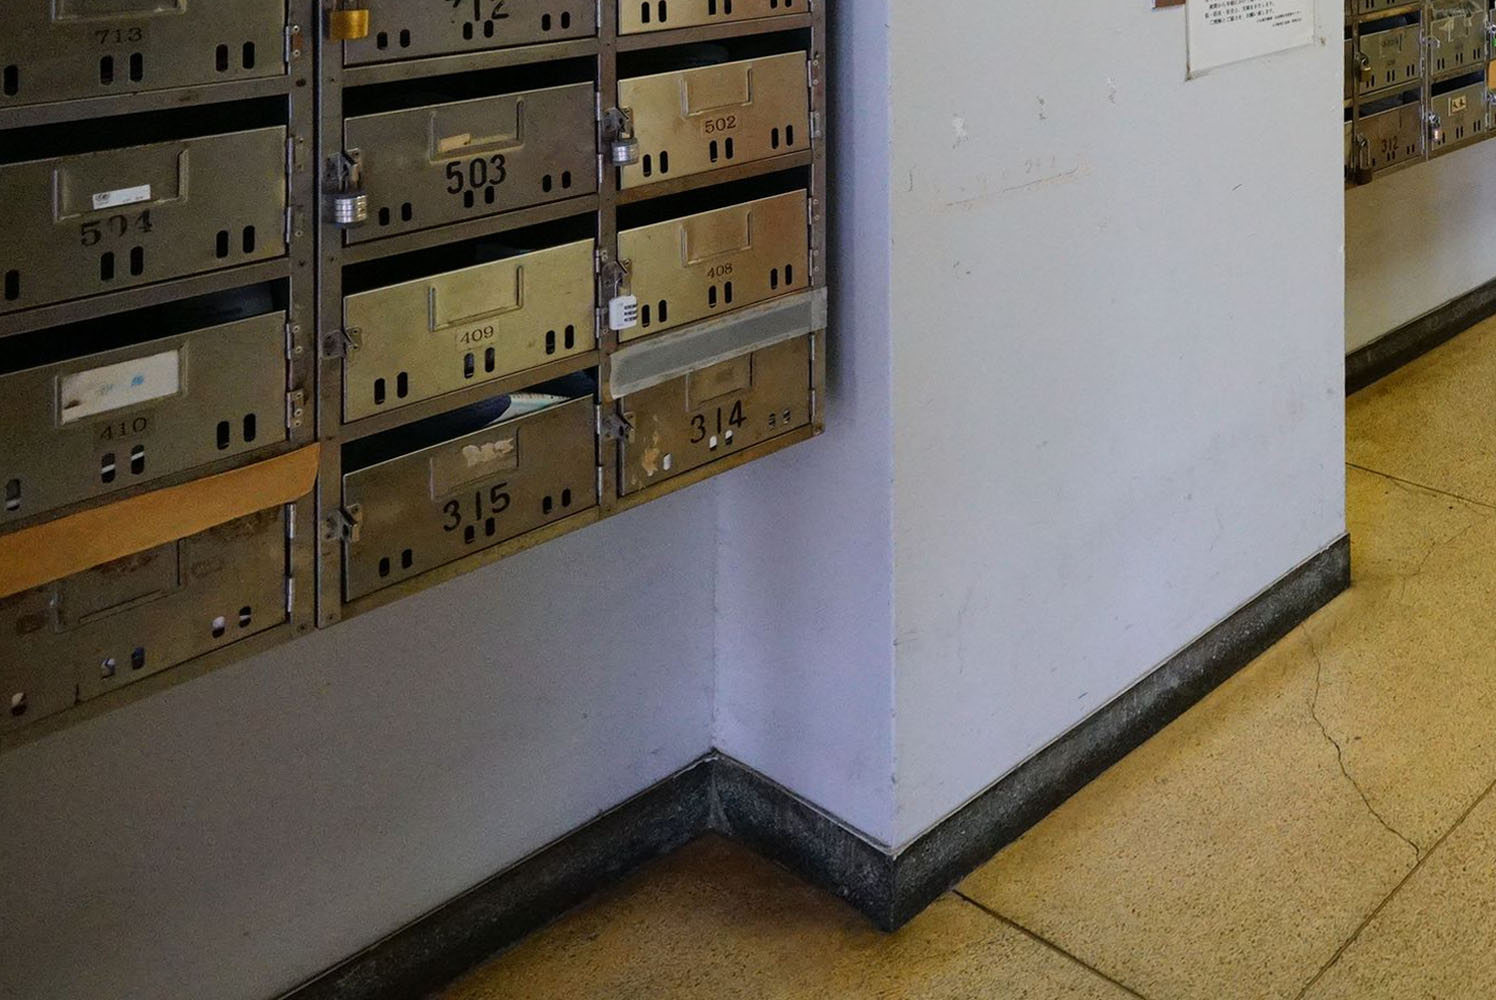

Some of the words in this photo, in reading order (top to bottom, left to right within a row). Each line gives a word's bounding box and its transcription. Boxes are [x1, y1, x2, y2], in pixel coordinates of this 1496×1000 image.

[97, 26, 143, 45] 713
[705, 115, 737, 134] 502
[446, 154, 507, 194] 503
[707, 262, 734, 280] 408
[459, 325, 495, 345] 409
[100, 416, 148, 441] 410
[690, 400, 747, 445] 314
[443, 483, 511, 531] 315
